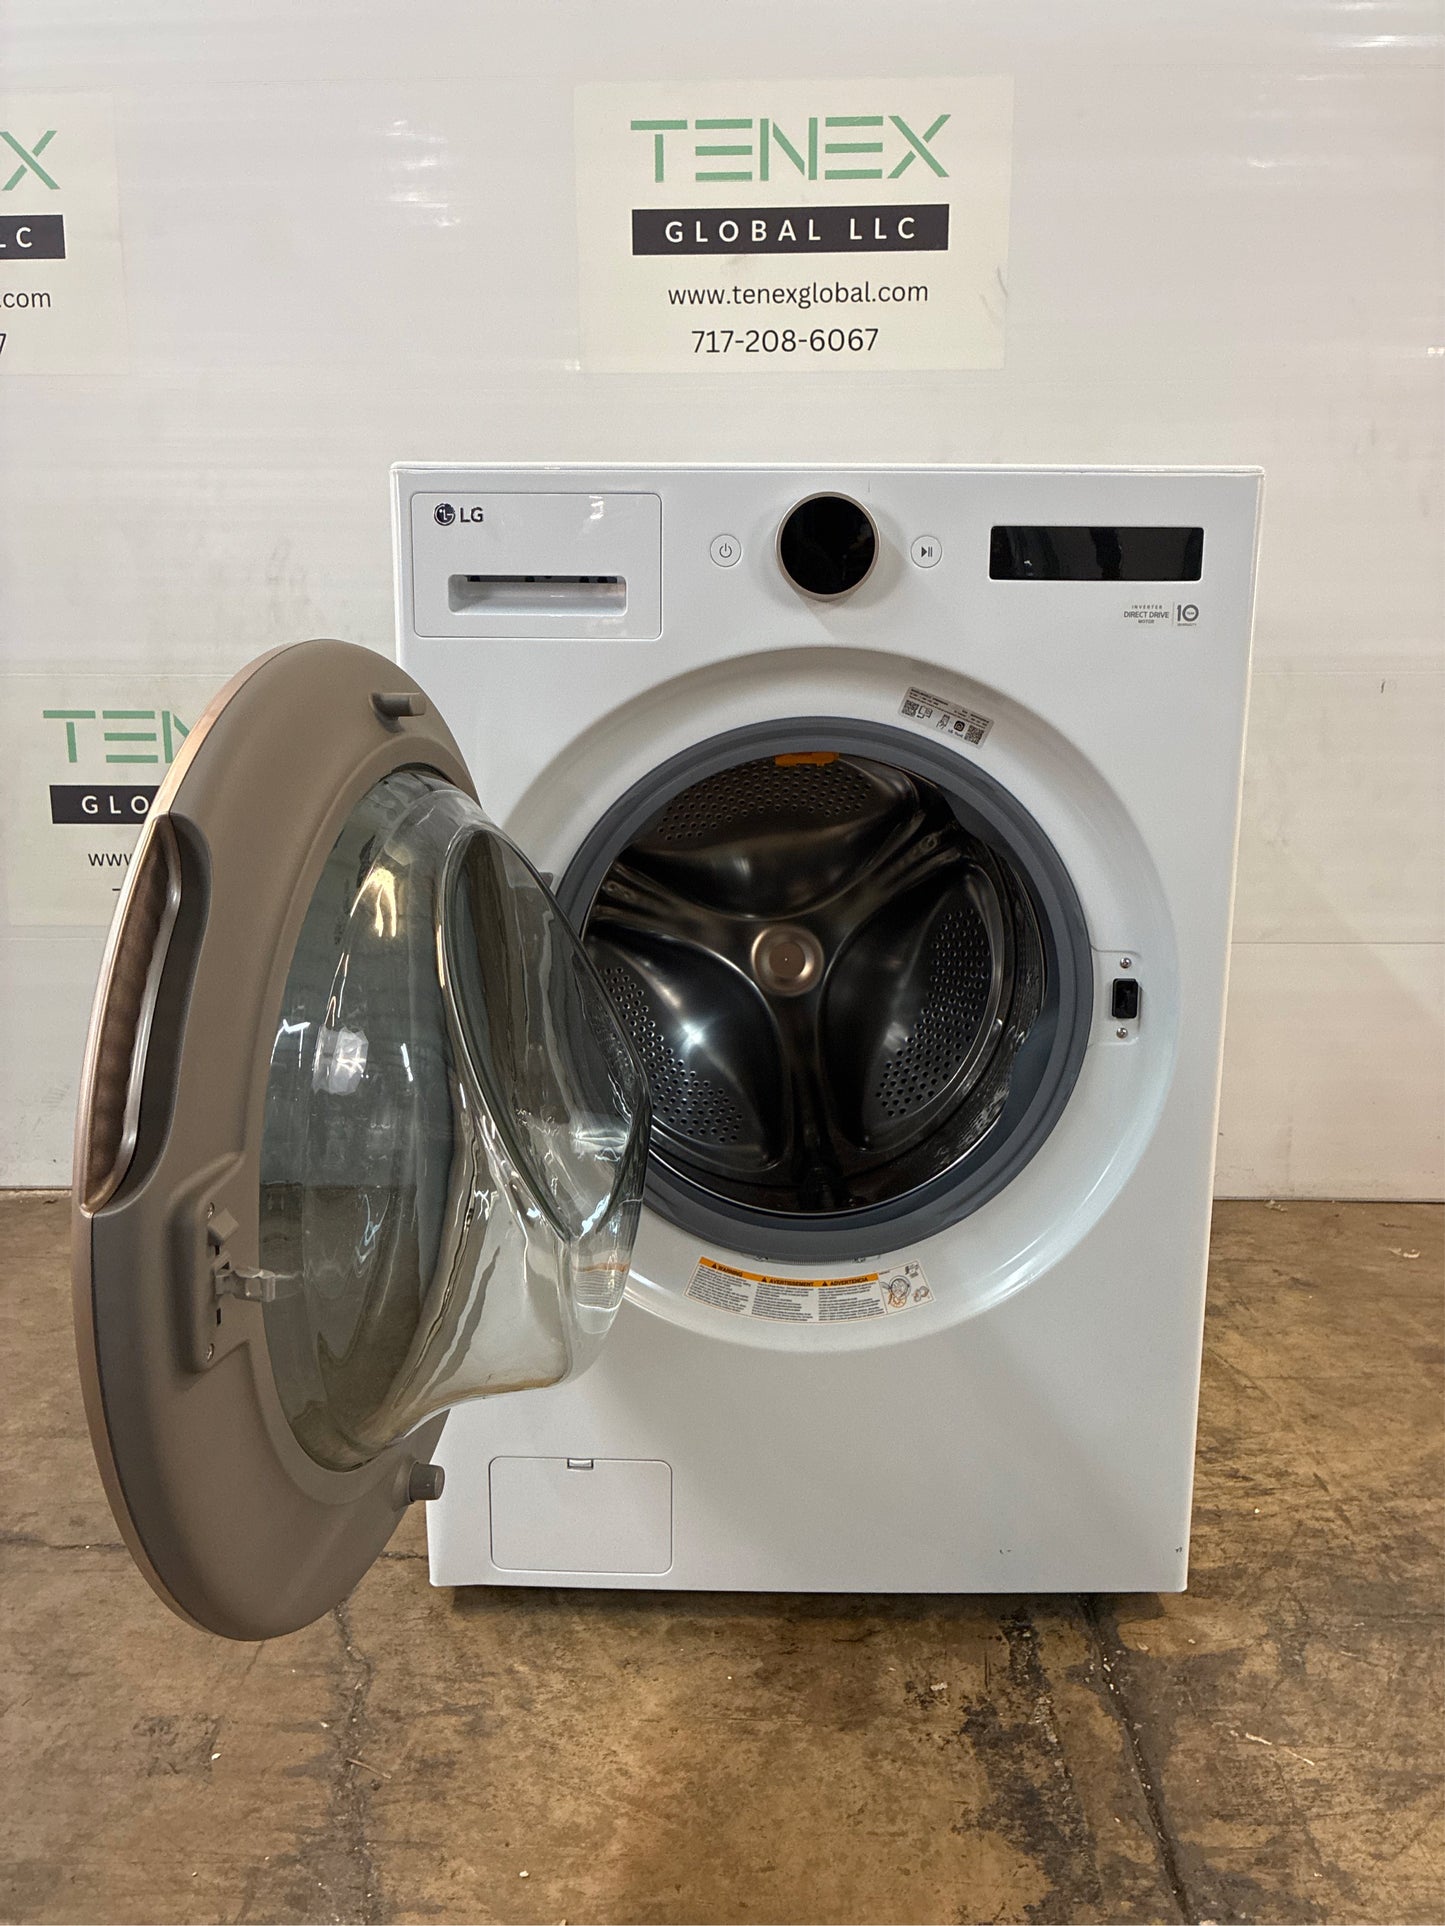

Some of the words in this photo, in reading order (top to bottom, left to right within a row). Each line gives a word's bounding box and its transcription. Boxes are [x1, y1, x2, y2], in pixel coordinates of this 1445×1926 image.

[630, 114, 951, 183] TENEX
[664, 219, 821, 243] GLOBAL
[849, 216, 916, 240] LLC
[667, 281, 929, 309] www.tenexglobal.com
[691, 327, 879, 353] 717-208-6067
[460, 506, 484, 523] LG
[1123, 611, 1148, 619] DIRECT
[1149, 611, 1169, 619] DRIVE
[43, 710, 190, 763] TEN
[81, 795, 149, 814] GLO
